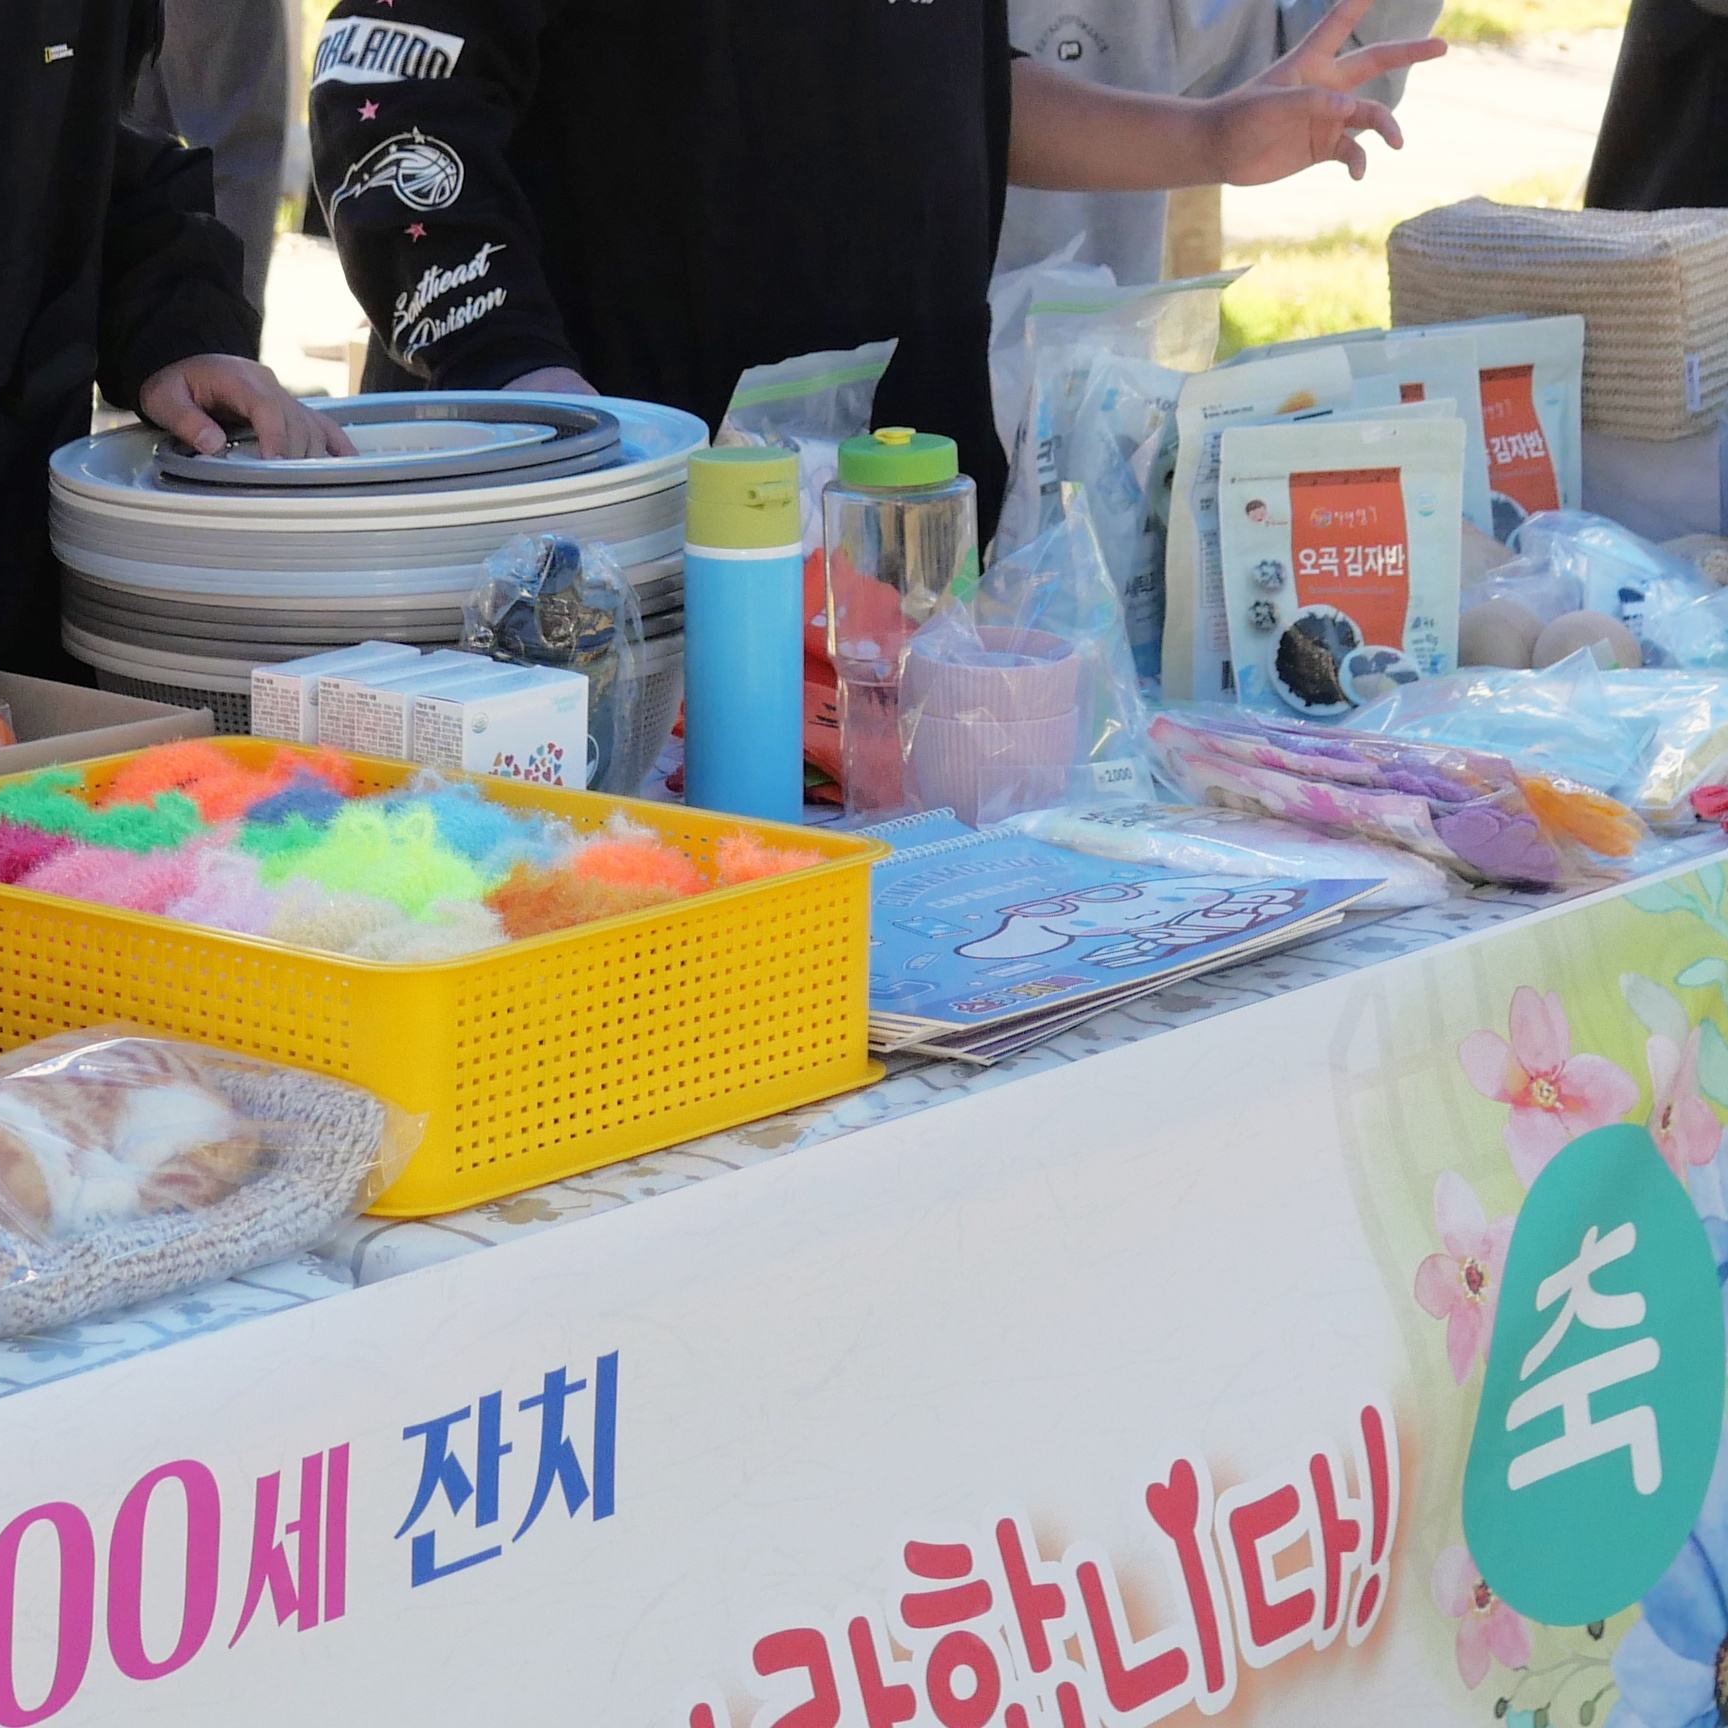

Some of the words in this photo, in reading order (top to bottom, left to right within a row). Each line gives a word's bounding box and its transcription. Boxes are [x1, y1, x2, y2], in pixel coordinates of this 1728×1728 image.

[392, 242, 507, 342] Southeast
[403, 287, 507, 364] Division
[1490, 430, 1545, 465] 김자반
[1298, 546, 1339, 577] 오곡
[1343, 543, 1406, 578] 김자반
[1506, 1221, 1663, 1496] 축
[394, 1348, 619, 1588] 잔치
